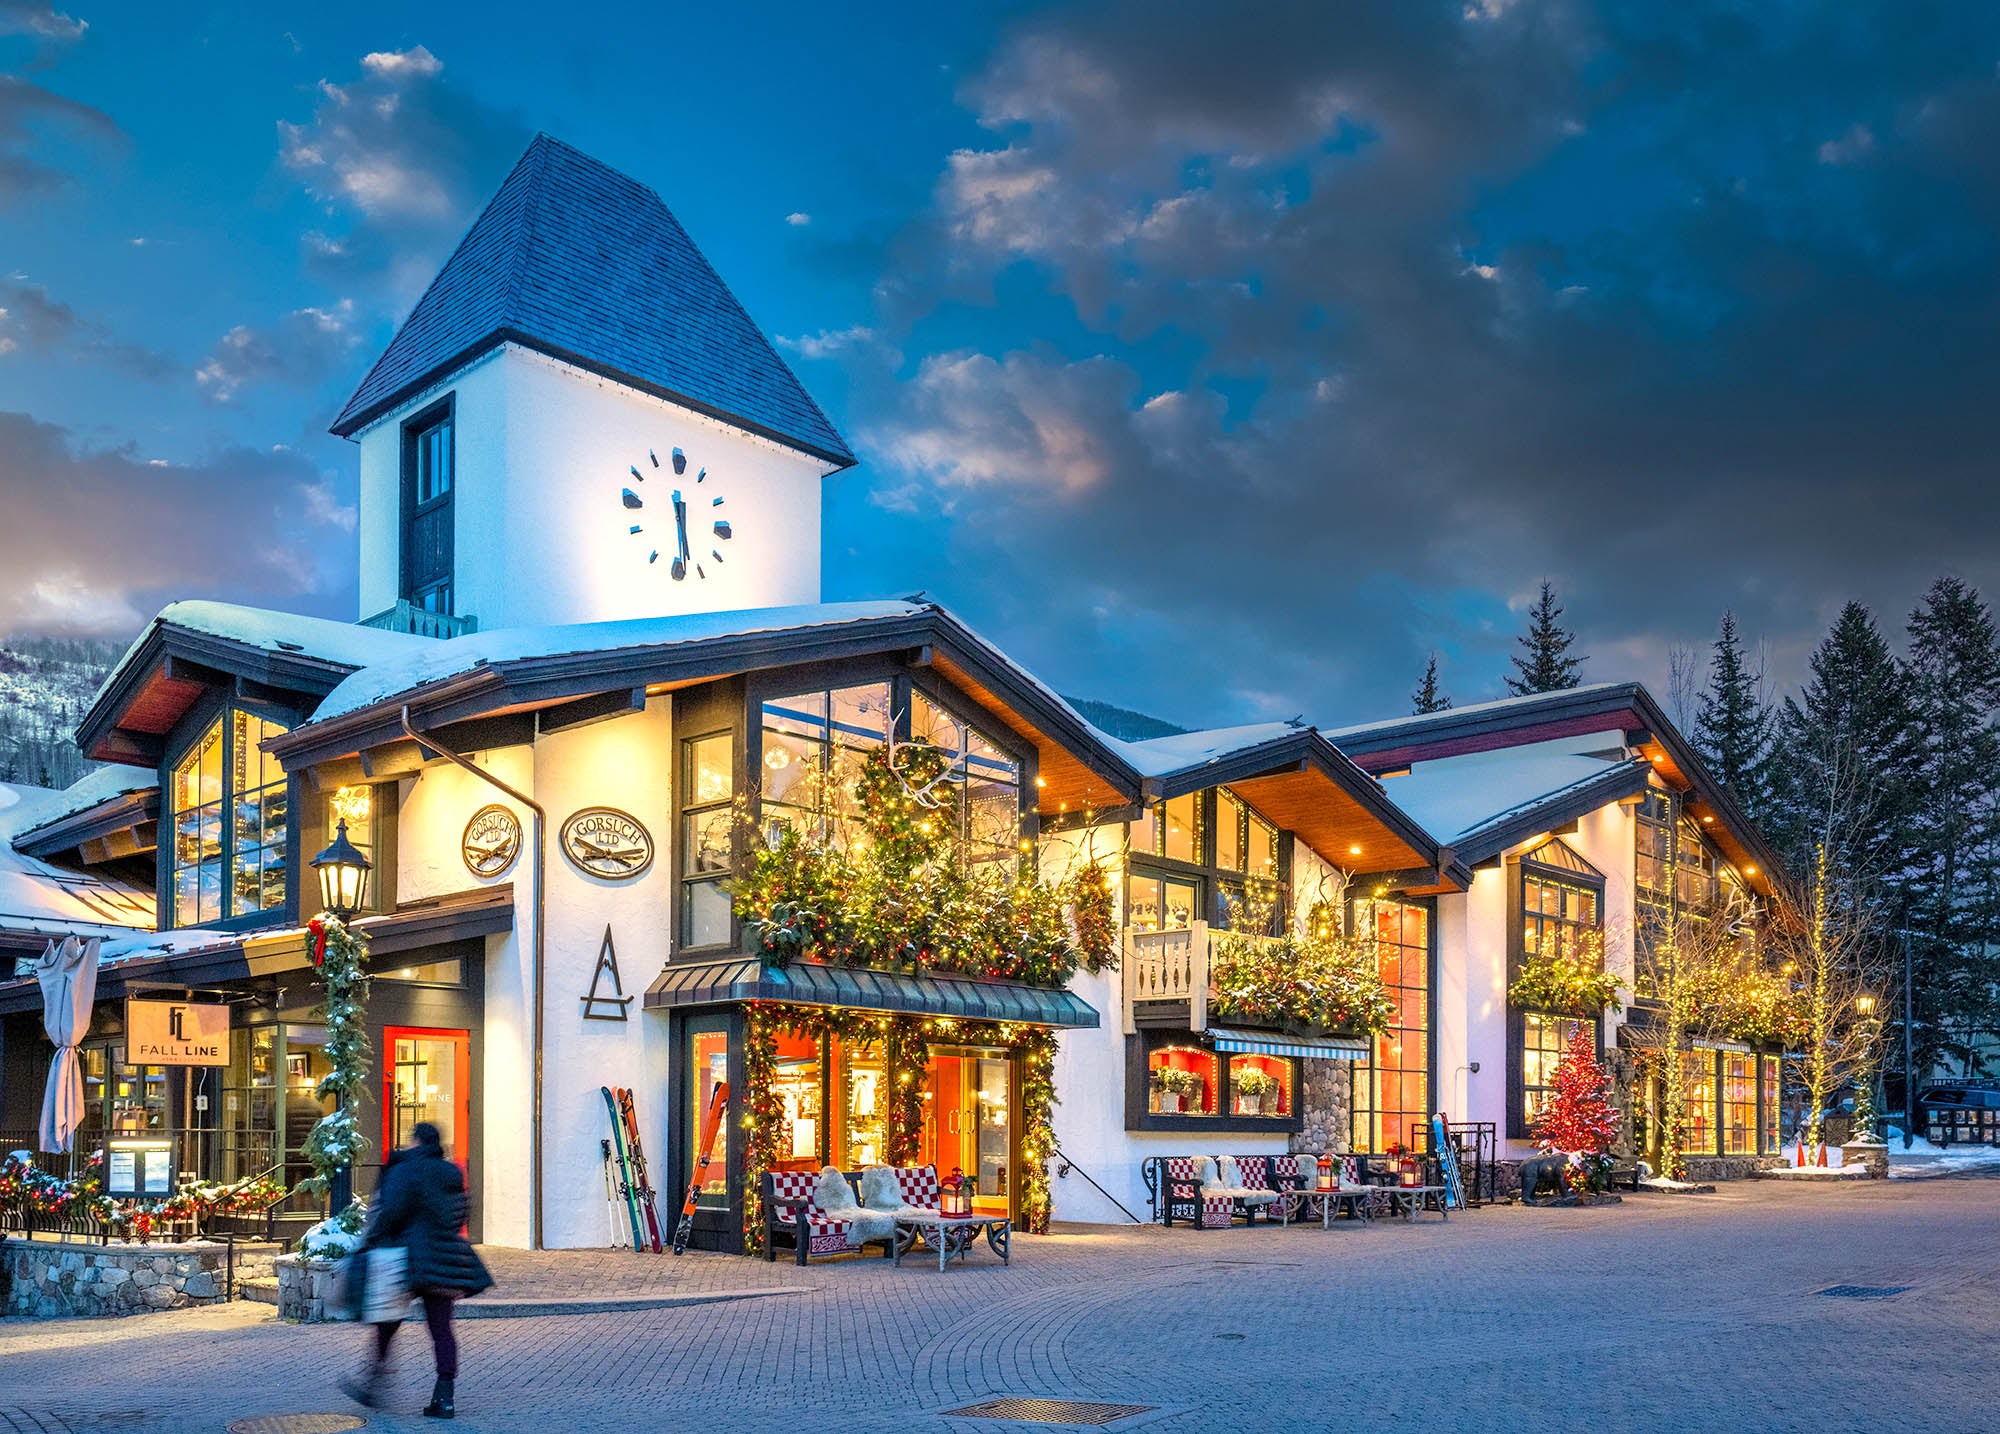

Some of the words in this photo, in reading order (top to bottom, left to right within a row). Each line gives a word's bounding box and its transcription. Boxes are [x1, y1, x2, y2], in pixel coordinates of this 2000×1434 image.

[471, 814, 514, 841] GORSUCH
[576, 817, 642, 845] GORSUCH
[598, 832, 620, 845] LTD
[140, 1045, 178, 1056] FALL
[185, 1046, 218, 1057] LINE
